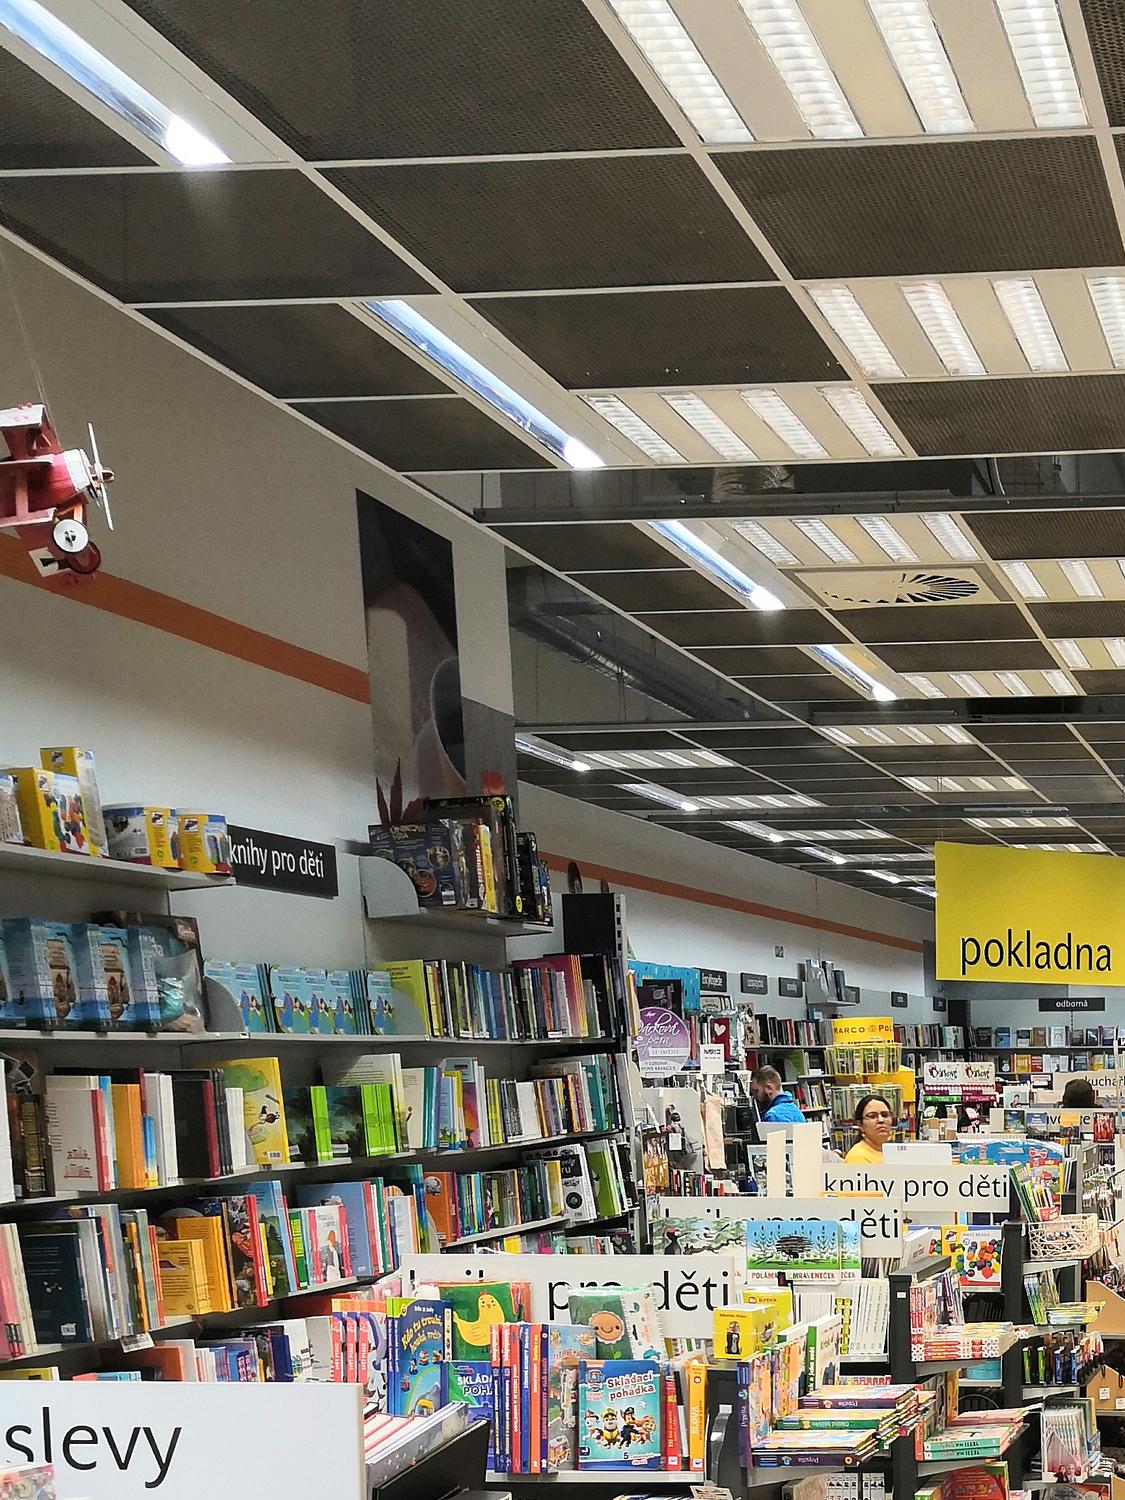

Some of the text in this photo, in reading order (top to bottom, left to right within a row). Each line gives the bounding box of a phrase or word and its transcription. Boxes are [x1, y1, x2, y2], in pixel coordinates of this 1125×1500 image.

[228, 835, 324, 878] knihy pro děti
[961, 929, 1112, 975] pokladna
[1056, 1000, 1088, 1008] odborná
[824, 1173, 1009, 1202] knihy pro děti
[792, 1270, 835, 1279] MRAVENEČEK
[607, 1373, 653, 1389] Skládací
[610, 1386, 655, 1401] pohádka
[5, 1406, 182, 1489] slevy
